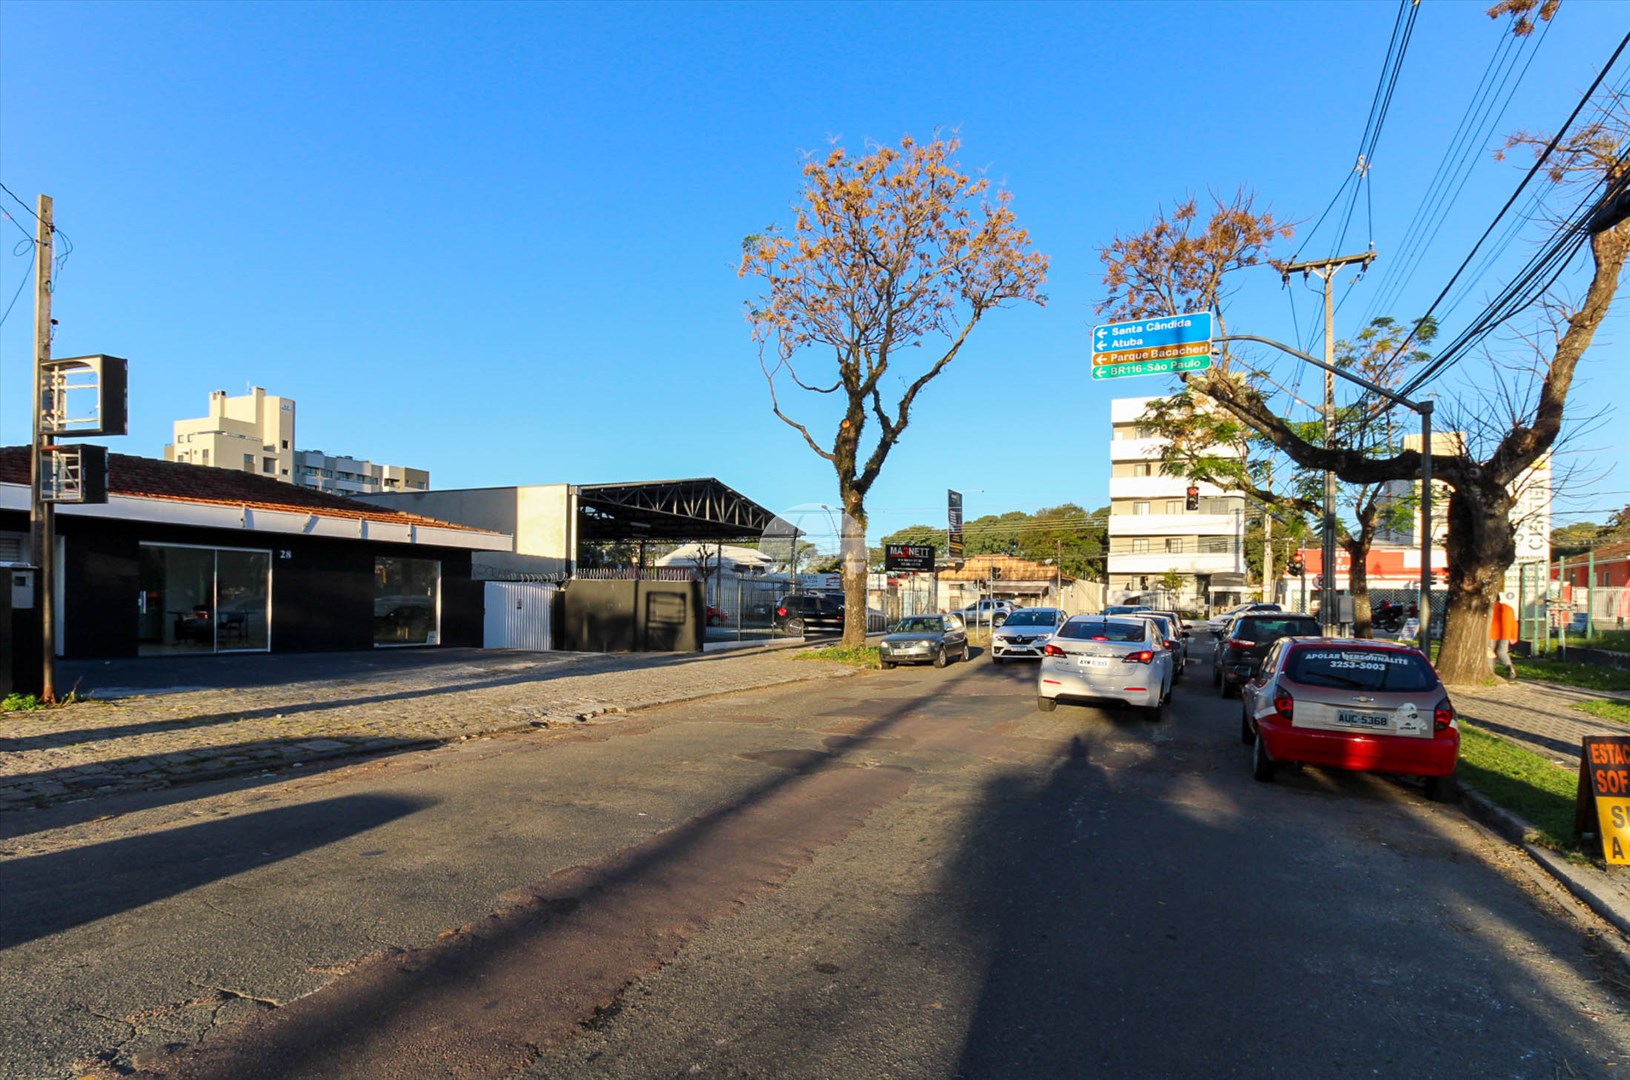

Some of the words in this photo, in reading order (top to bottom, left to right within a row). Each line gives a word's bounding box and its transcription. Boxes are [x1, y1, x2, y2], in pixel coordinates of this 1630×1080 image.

[1111, 324, 1143, 336] Santa
[1146, 319, 1192, 332] Cândida
[1111, 338, 1144, 349] Atuba
[1110, 351, 1149, 363] Parque
[1150, 344, 1208, 358] Bacacheri
[1110, 363, 1168, 376] BR116-São
[1170, 360, 1201, 372] Paulo
[1329, 660, 1386, 671] 3253-5003
